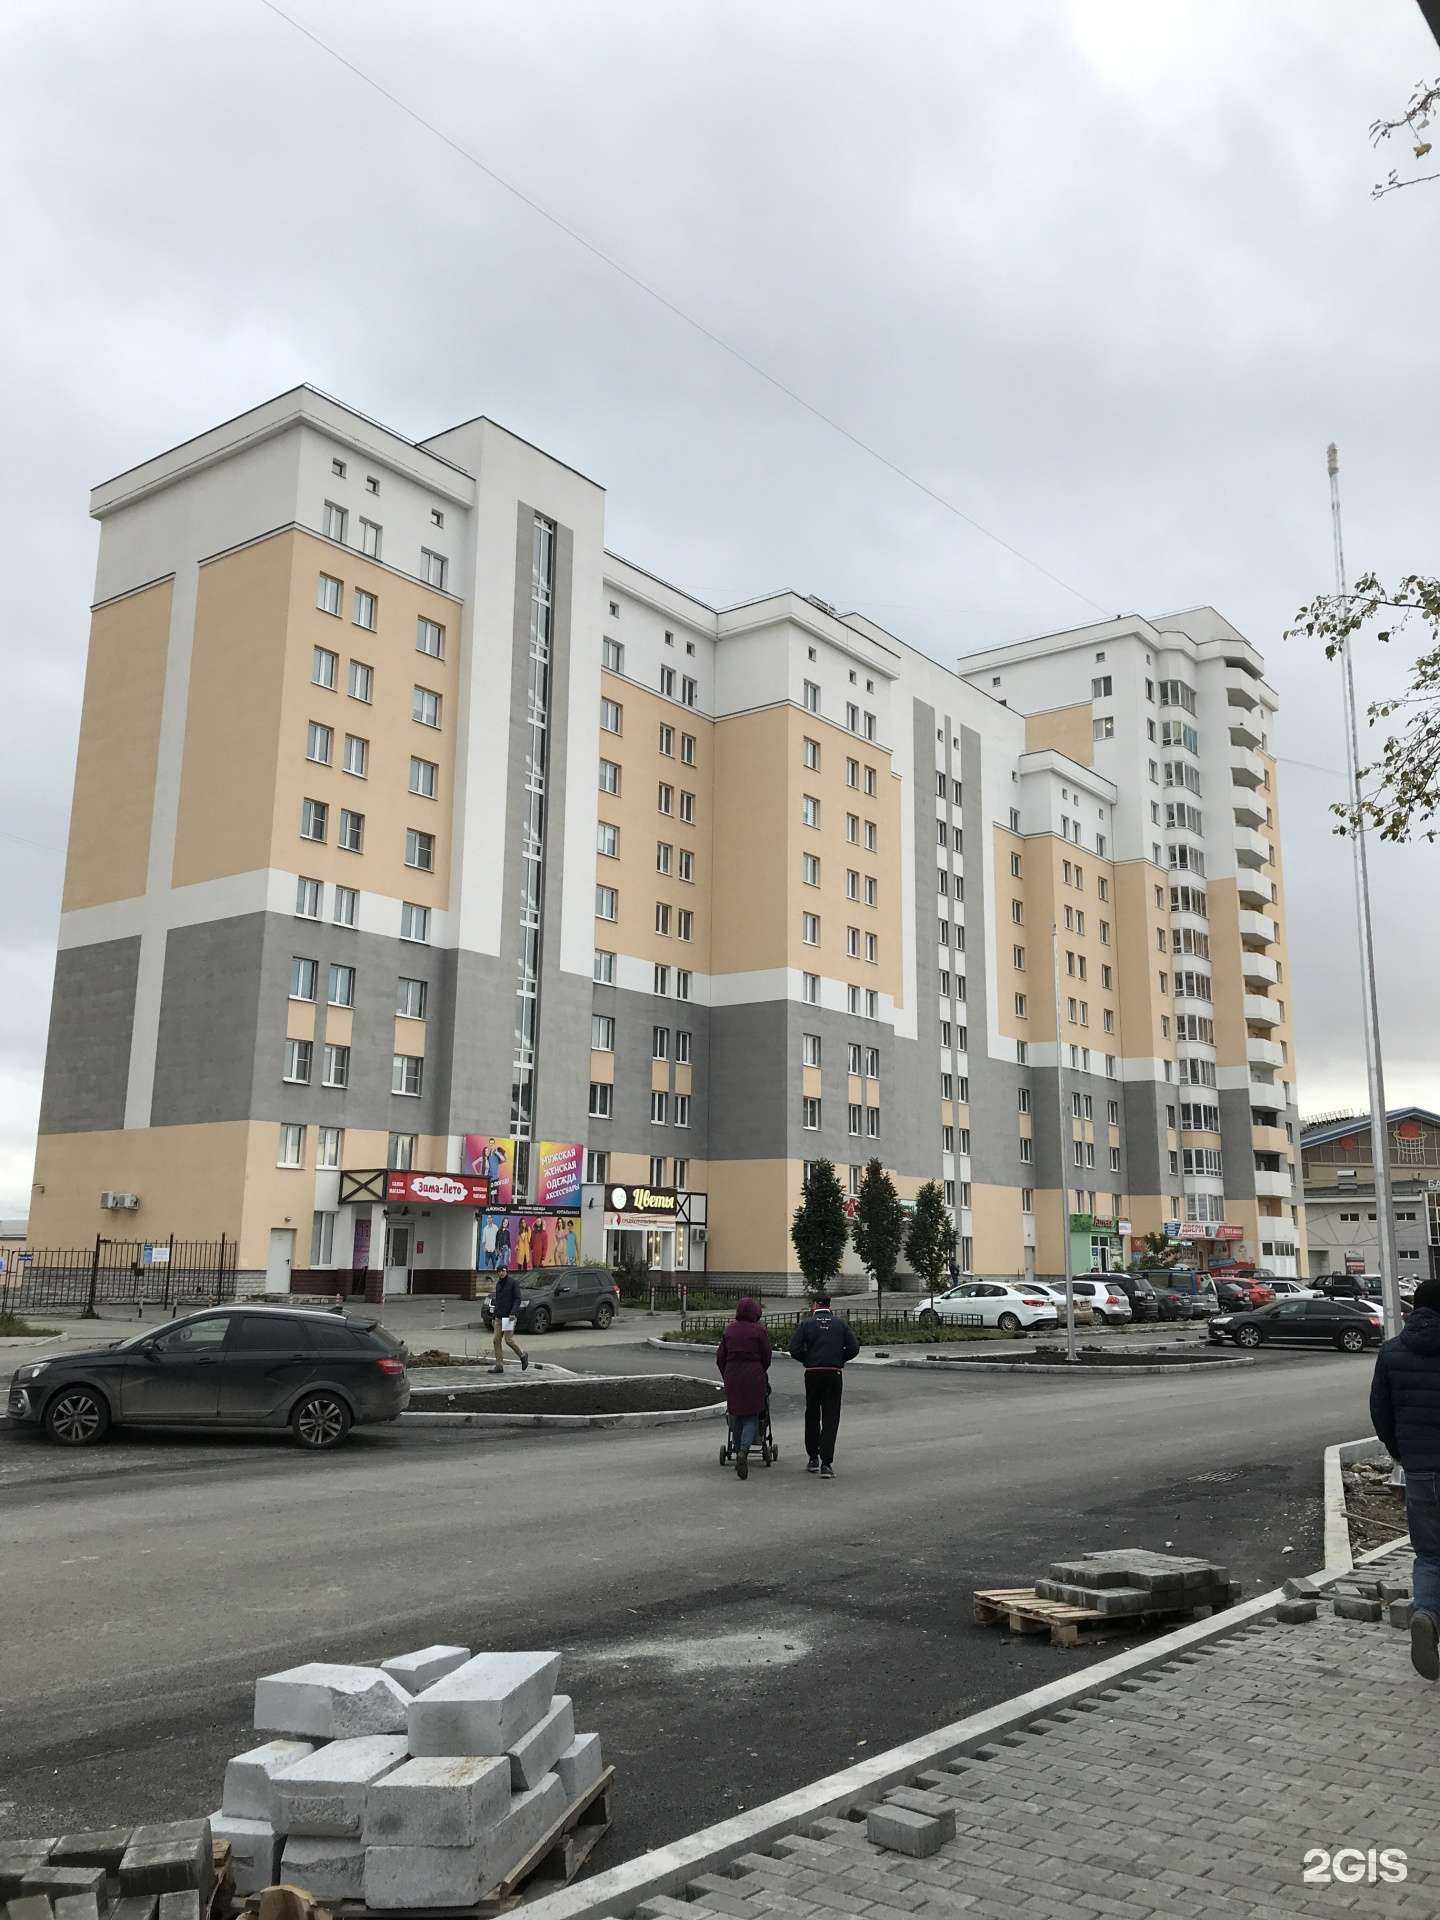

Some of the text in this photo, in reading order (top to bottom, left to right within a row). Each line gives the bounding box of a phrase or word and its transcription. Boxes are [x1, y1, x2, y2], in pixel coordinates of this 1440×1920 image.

[541, 1147, 576, 1166] МУЖСКАЯ
[543, 1160, 577, 1177] ЖЕНСКАЯ
[418, 1181, 462, 1195] Зима-Лето
[546, 1172, 577, 1190] ОДЕЖДА
[545, 1183, 580, 1200] АКСЕССУАРЫ
[632, 1188, 675, 1210] Цветы
